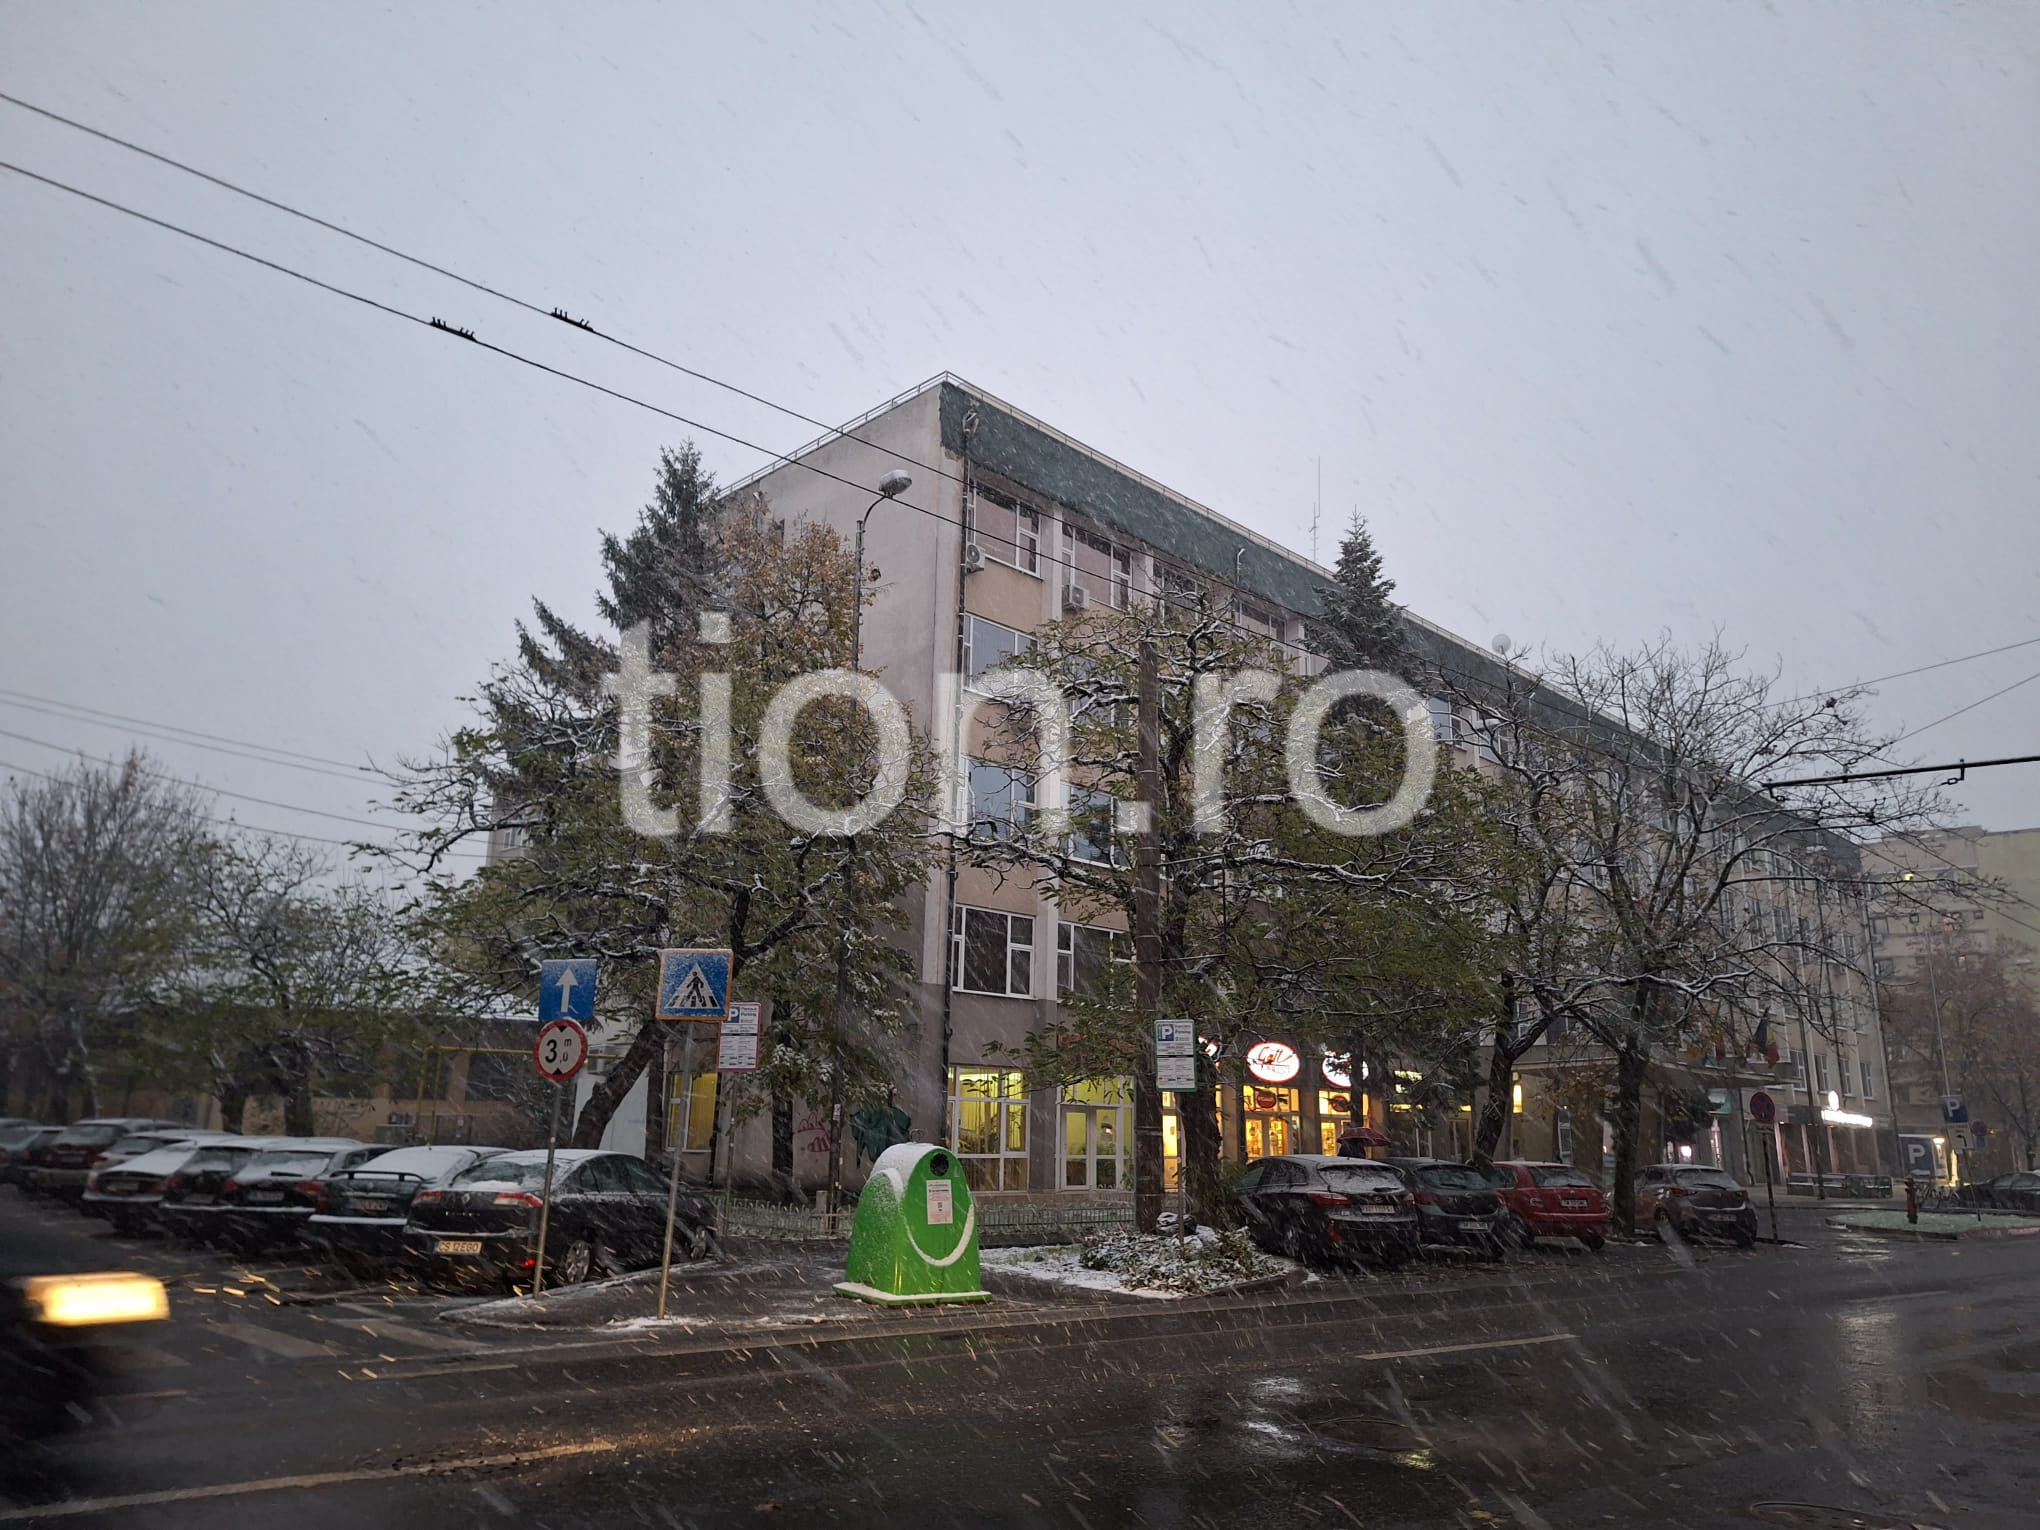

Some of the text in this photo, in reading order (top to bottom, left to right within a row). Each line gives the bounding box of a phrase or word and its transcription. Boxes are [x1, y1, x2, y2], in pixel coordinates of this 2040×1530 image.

[728, 1008, 739, 1021] P
[1161, 1026, 1173, 1040] P
[1945, 1099, 1961, 1117] P
[1908, 1144, 1926, 1164] P
